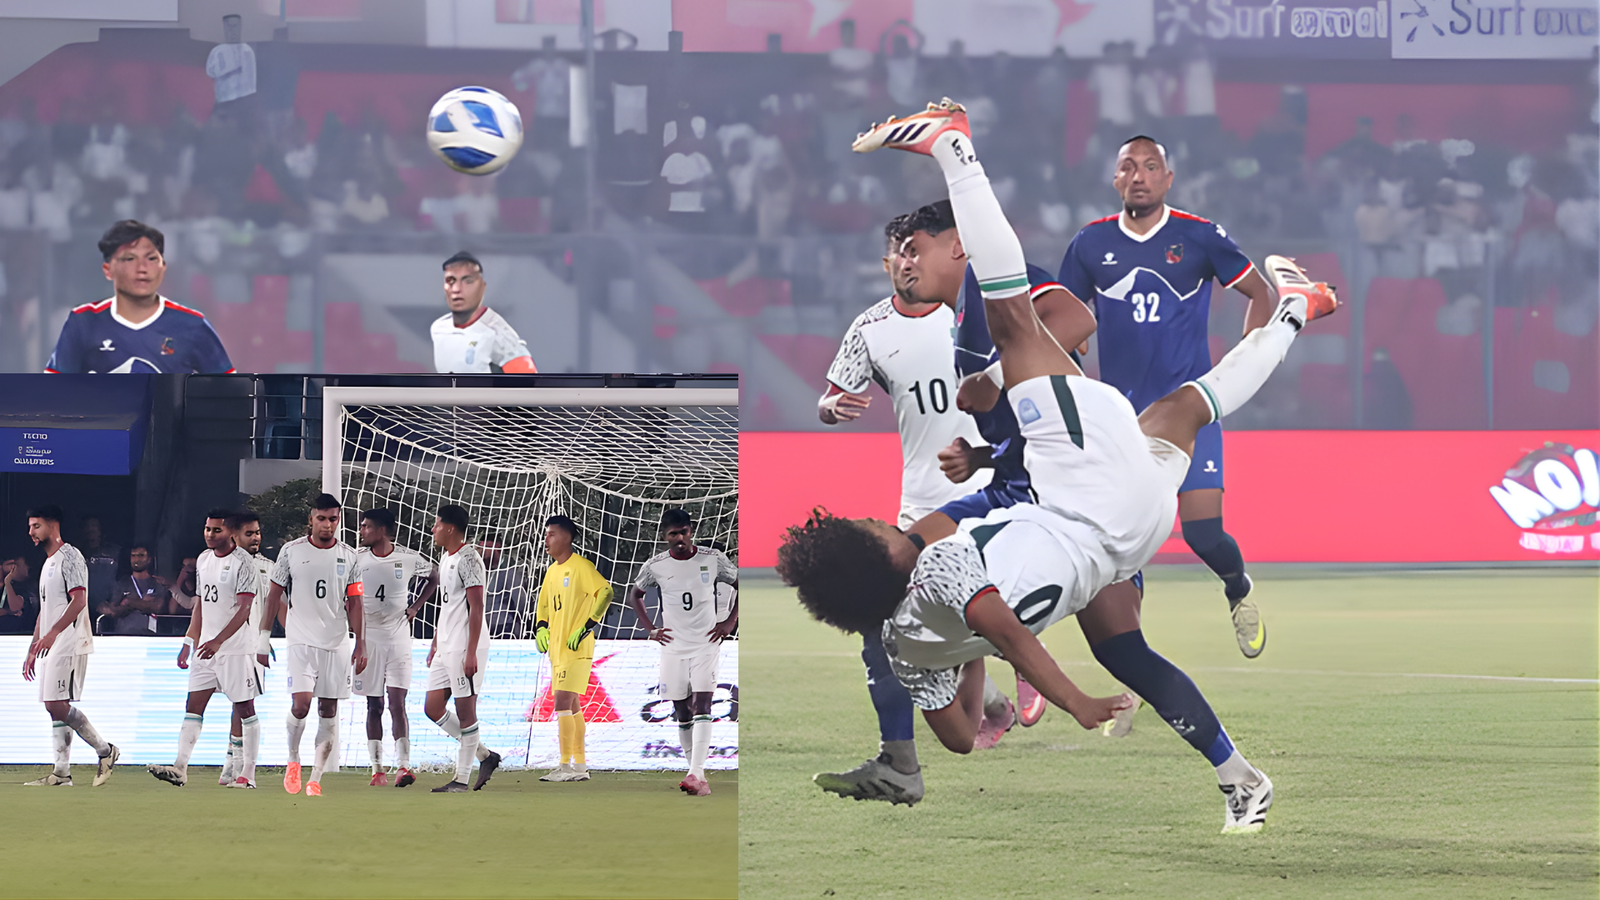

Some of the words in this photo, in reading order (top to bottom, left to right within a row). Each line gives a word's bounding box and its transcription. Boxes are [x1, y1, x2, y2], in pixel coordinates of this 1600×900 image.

[1131, 292, 1161, 323] 32
[908, 378, 949, 415] 10
[203, 583, 219, 603] 23
[315, 579, 327, 599] 6
[375, 583, 386, 602] 4
[682, 591, 694, 611] 9
[57, 679, 66, 689] 14
